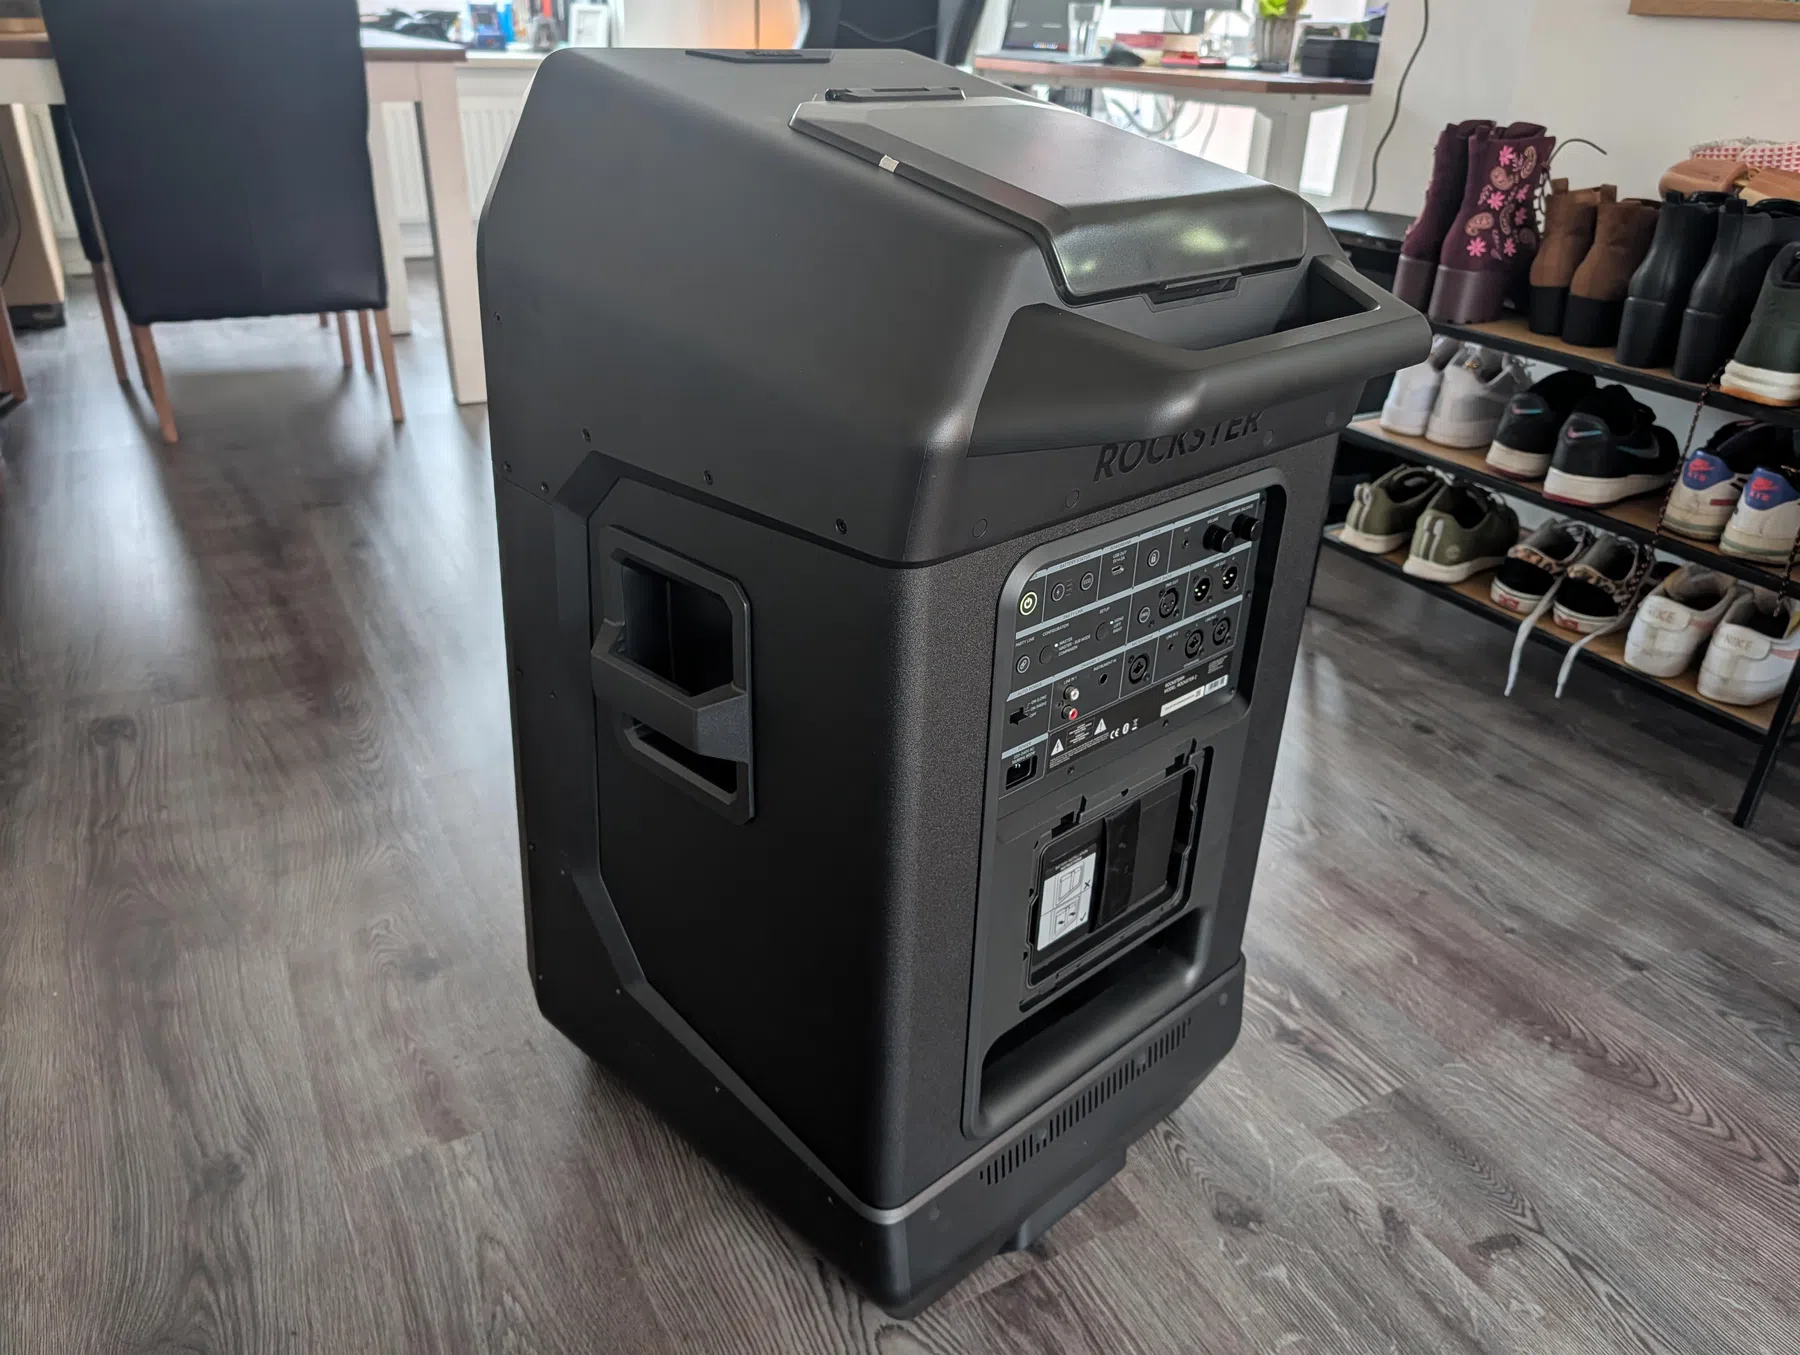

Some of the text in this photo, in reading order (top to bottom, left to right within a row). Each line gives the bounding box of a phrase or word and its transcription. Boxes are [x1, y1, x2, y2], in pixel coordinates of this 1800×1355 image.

[1059, 554, 1091, 569] BATTERY STATUS
[1099, 606, 1110, 614] SETUP
[1042, 622, 1070, 637] CONFIGURATION
[1058, 642, 1072, 651] MASTER
[1059, 637, 1073, 645] MASTER
[1725, 633, 1753, 650] NIKE
[1058, 645, 1078, 657] COMPANION
[1016, 682, 1042, 696] AUTO POWER
[1109, 727, 1120, 740] CE
[1017, 741, 1032, 751] POWER
